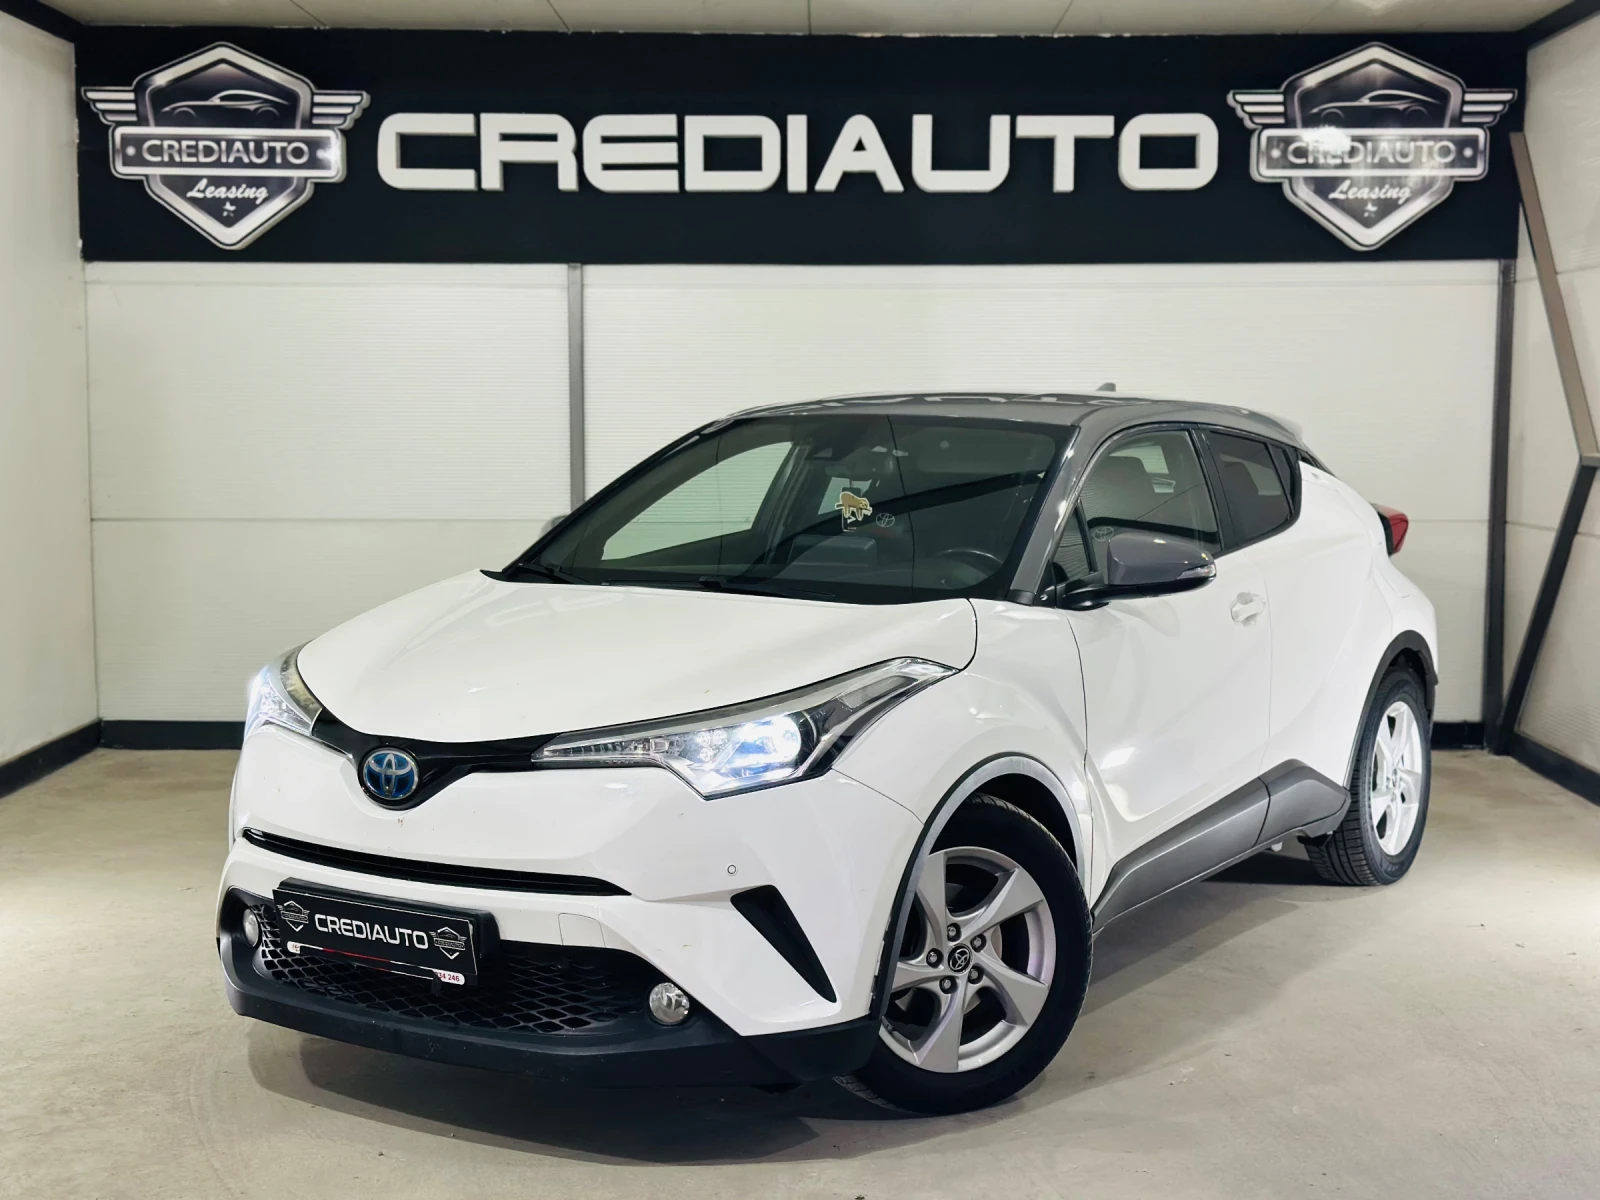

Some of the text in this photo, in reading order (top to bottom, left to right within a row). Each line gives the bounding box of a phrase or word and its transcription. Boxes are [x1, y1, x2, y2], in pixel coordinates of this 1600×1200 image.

[142, 139, 309, 164] CREDIAUTO
[376, 113, 1219, 193] CREDIAUTO
[186, 178, 269, 204] Leasing
[1328, 179, 1412, 205] Leasing
[314, 914, 429, 949] CREDIAUTO
